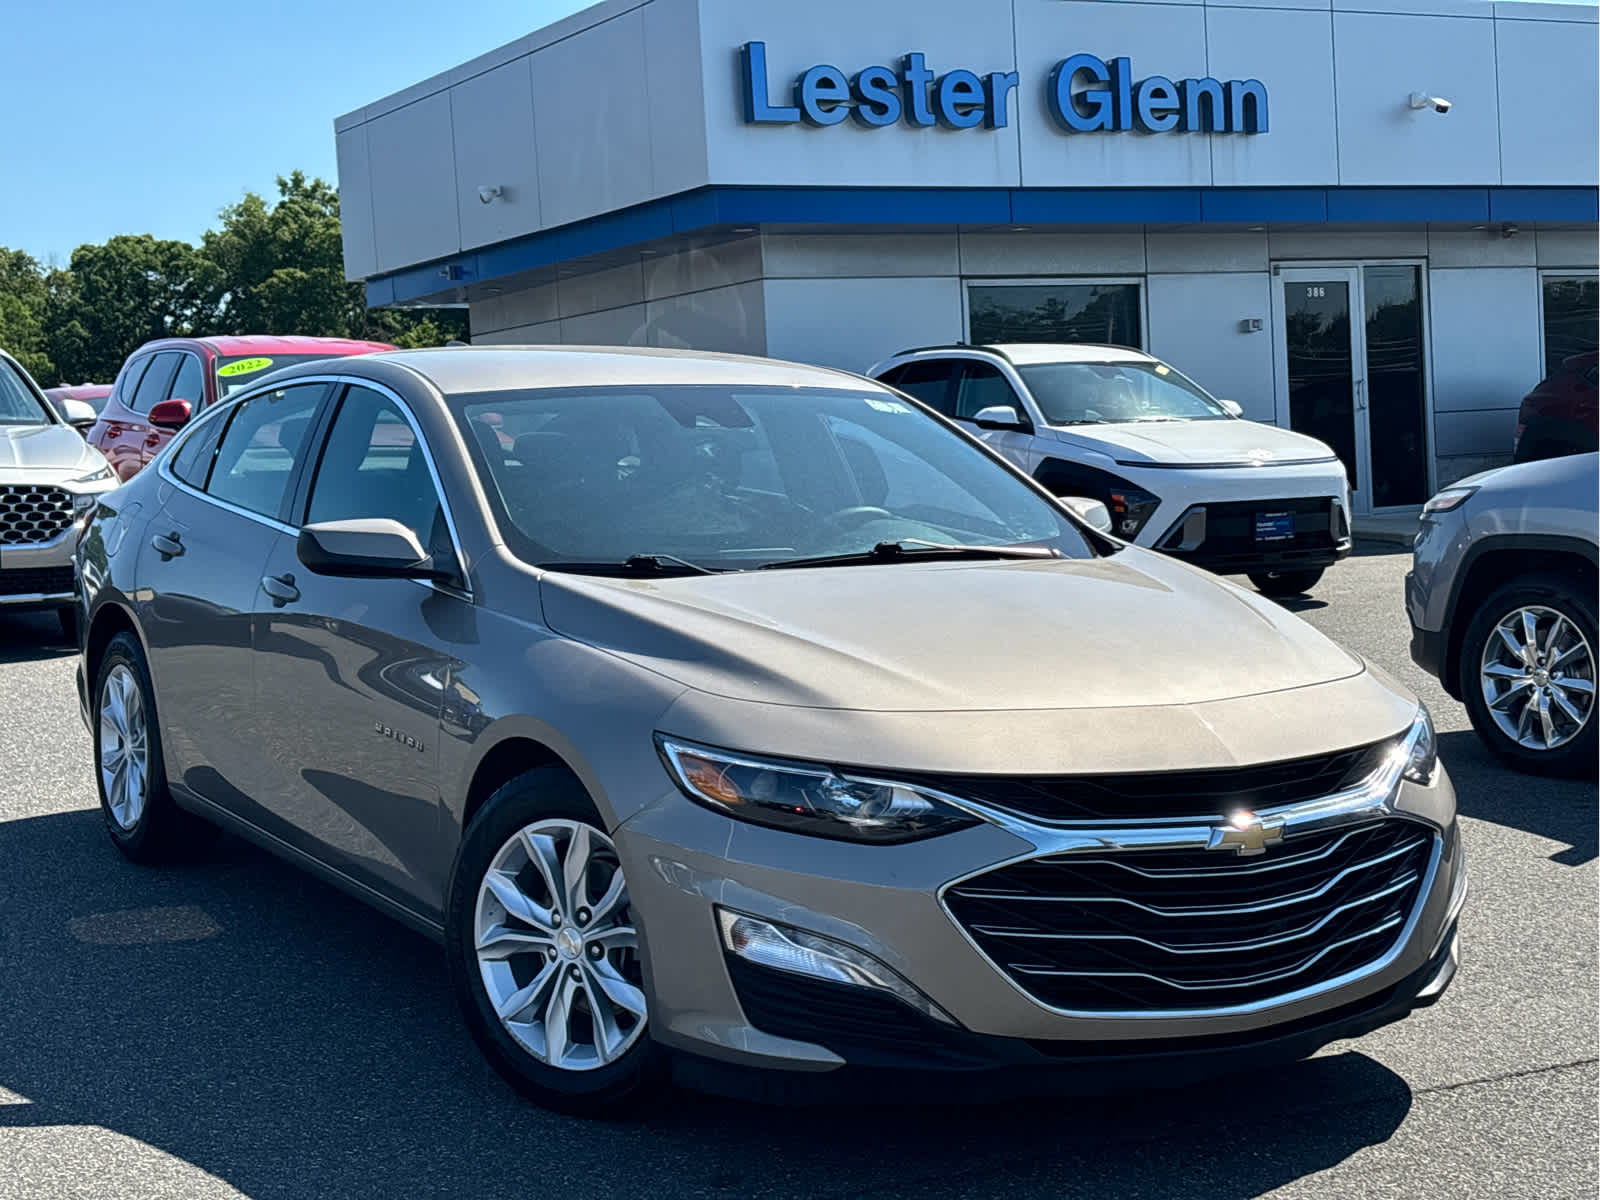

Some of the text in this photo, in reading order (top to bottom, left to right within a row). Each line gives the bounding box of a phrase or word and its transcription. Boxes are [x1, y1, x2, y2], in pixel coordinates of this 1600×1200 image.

[740, 41, 1269, 135] Lester Glenn
[1306, 287, 1325, 297] 386
[228, 359, 264, 374] 2022
